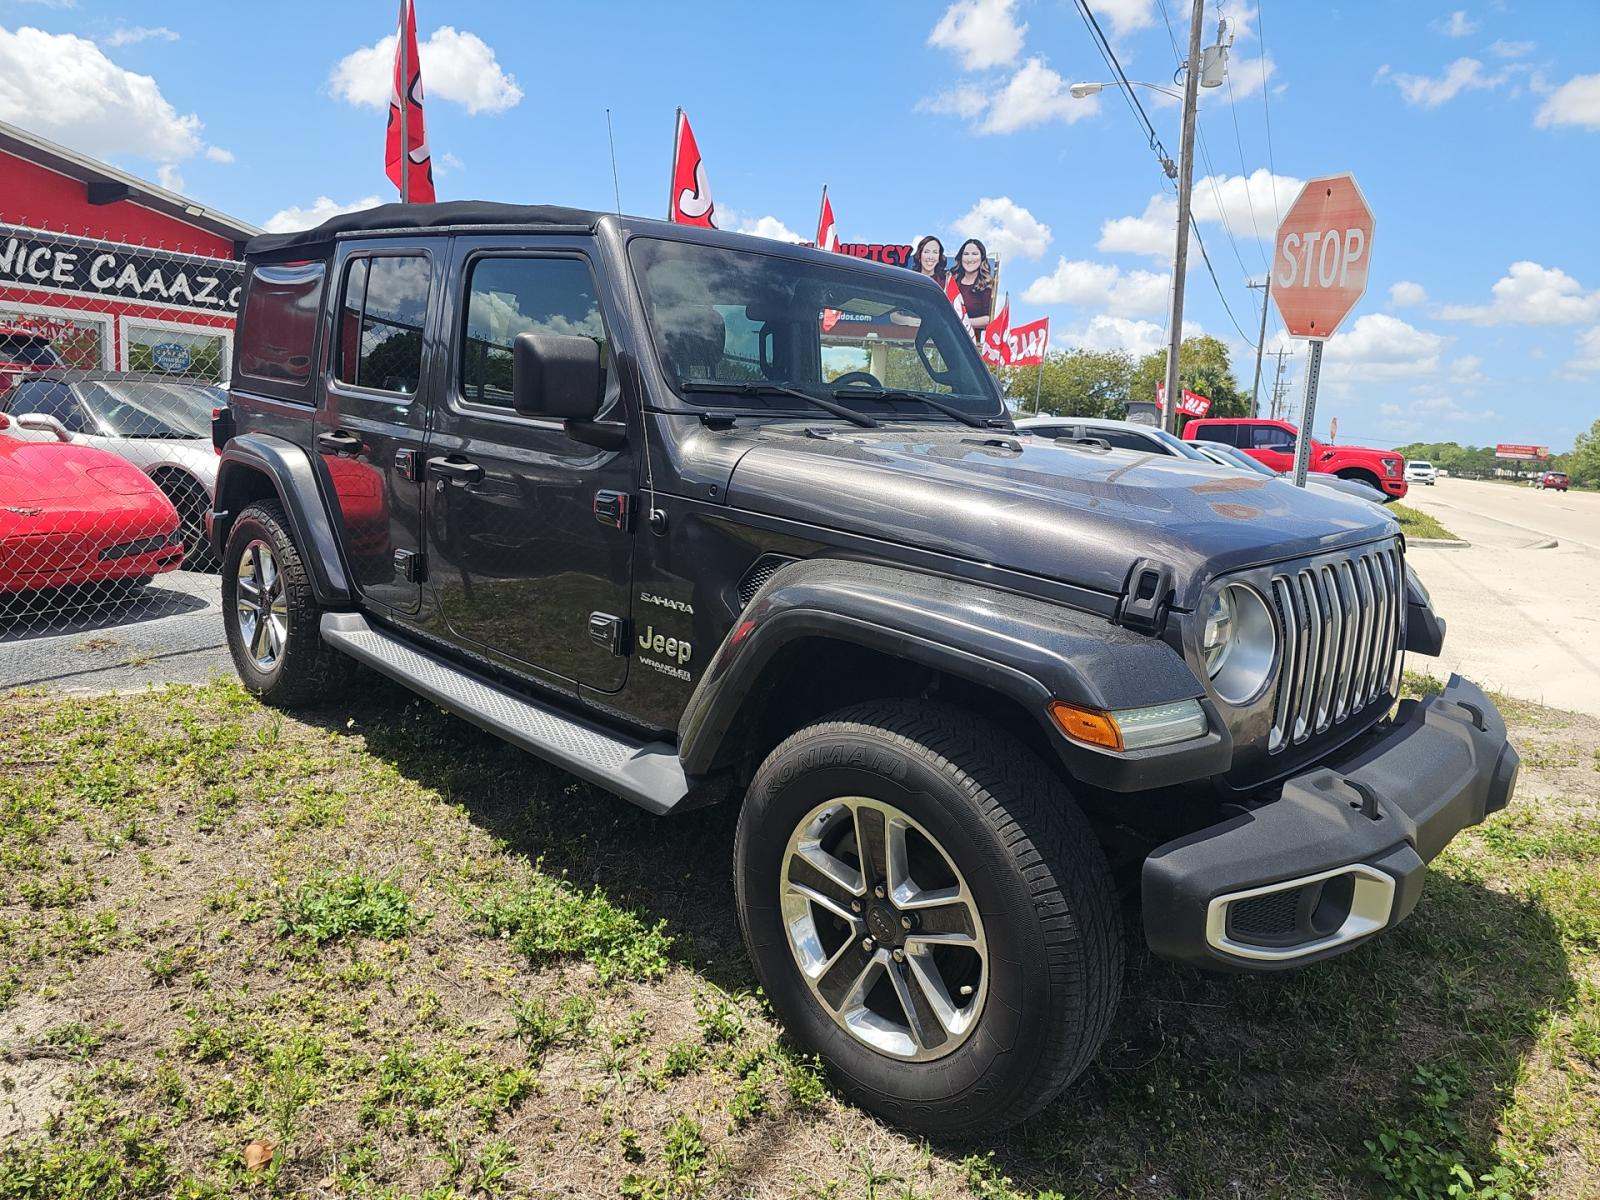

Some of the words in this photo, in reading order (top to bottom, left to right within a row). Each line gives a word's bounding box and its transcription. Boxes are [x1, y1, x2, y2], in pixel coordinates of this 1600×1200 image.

[1278, 228, 1364, 288] STOP
[640, 592, 694, 615] SAHARA
[639, 626, 692, 665] Jeep
[639, 655, 691, 680] WRANGLER
